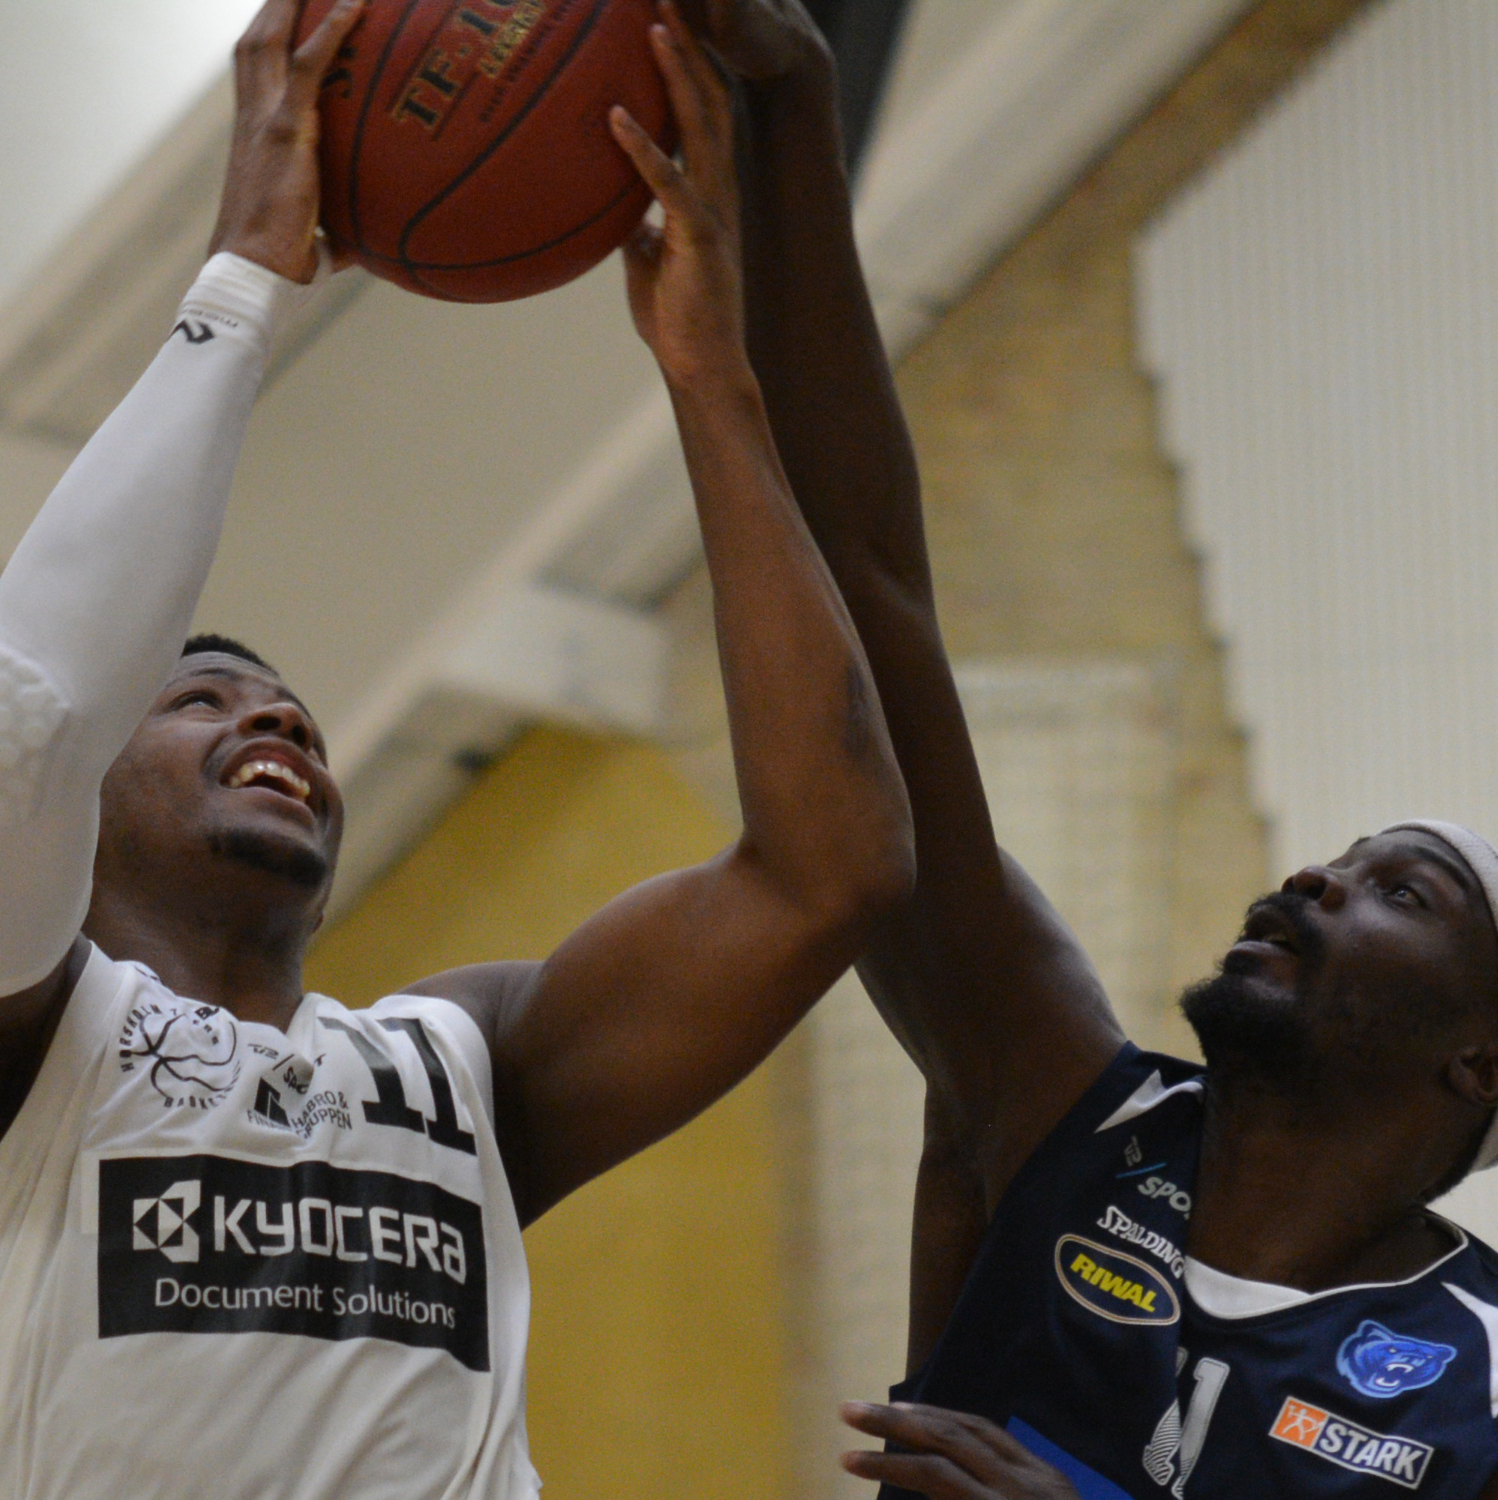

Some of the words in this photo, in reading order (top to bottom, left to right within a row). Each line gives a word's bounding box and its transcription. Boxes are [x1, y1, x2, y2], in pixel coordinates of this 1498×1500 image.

[316, 1016, 478, 1157] 11
[1096, 1205, 1185, 1280] SPALDING
[154, 1277, 324, 1312] Document
[332, 1285, 456, 1329] Solutions
[1069, 1253, 1157, 1313] RIWAL
[1319, 1422, 1424, 1481] STARK
